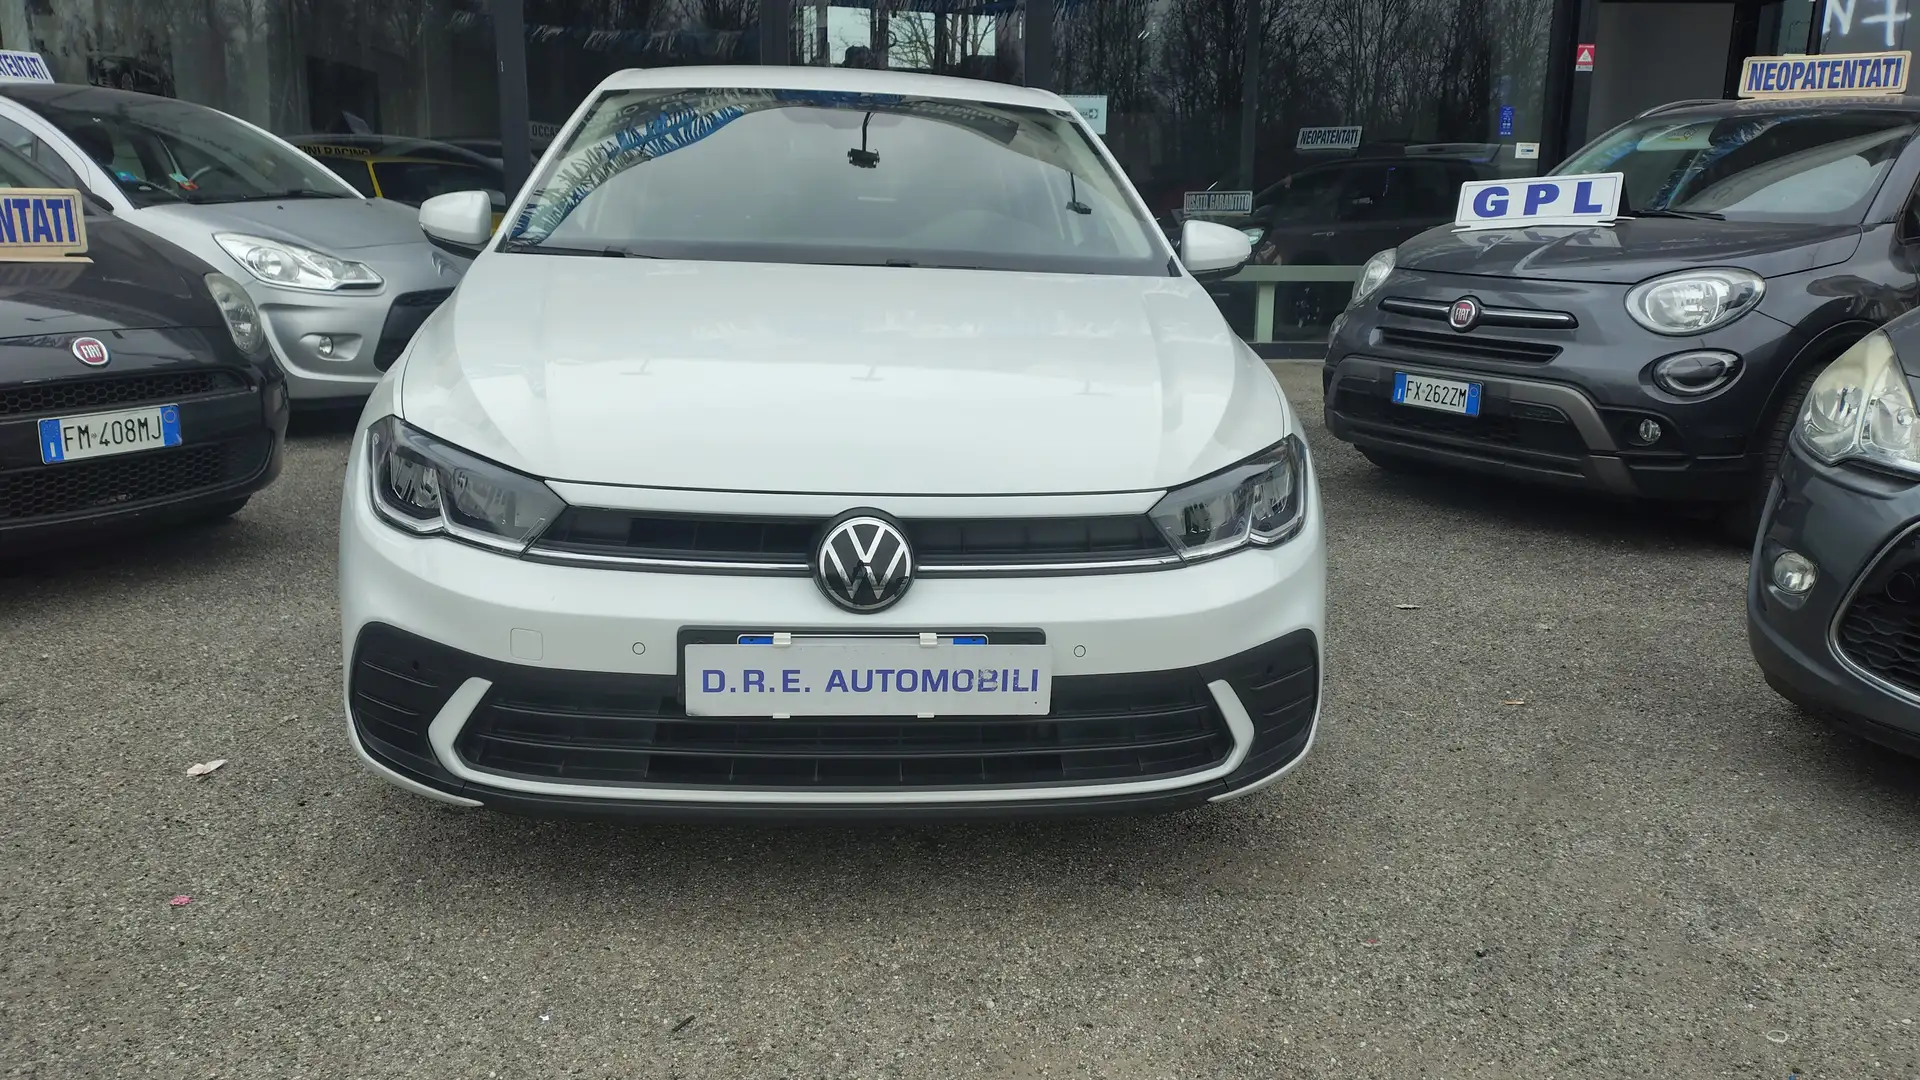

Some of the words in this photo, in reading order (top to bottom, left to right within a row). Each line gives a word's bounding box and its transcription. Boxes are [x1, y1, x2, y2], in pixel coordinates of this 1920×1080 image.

[1748, 57, 1903, 91] NEOPATENTATI
[1300, 129, 1359, 145] NEOPATENTATI
[1186, 194, 1209, 211] USATO
[1209, 194, 1250, 211] GARANTITO
[1455, 307, 1471, 321] FIAT
[81, 344, 103, 359] FIAT
[702, 669, 811, 693] D.R.E.
[824, 668, 1039, 693] AUTOMOBILI
